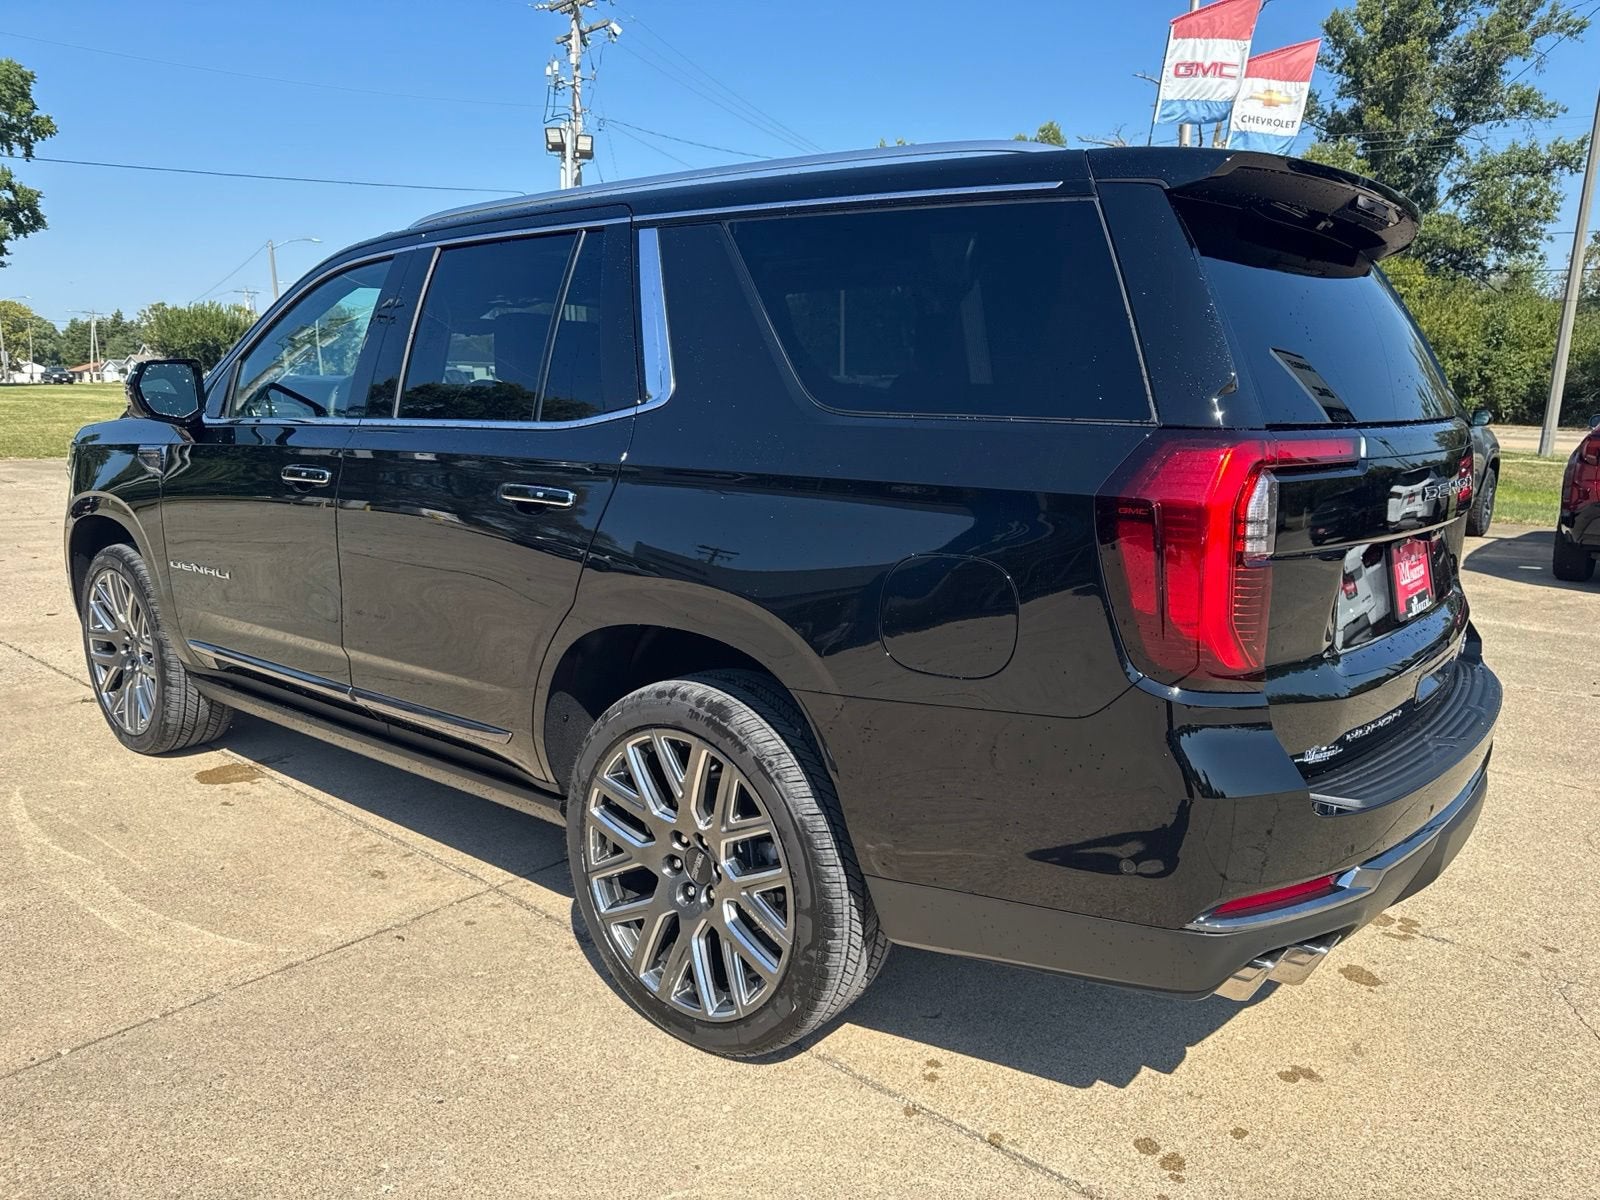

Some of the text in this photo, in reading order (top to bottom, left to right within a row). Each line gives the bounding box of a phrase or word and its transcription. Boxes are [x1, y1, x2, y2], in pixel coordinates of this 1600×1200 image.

[1173, 61, 1239, 79] GMC
[1240, 113, 1297, 129] CHEVROLET
[1118, 507, 1149, 515] GMC
[169, 560, 231, 580] DENALI
